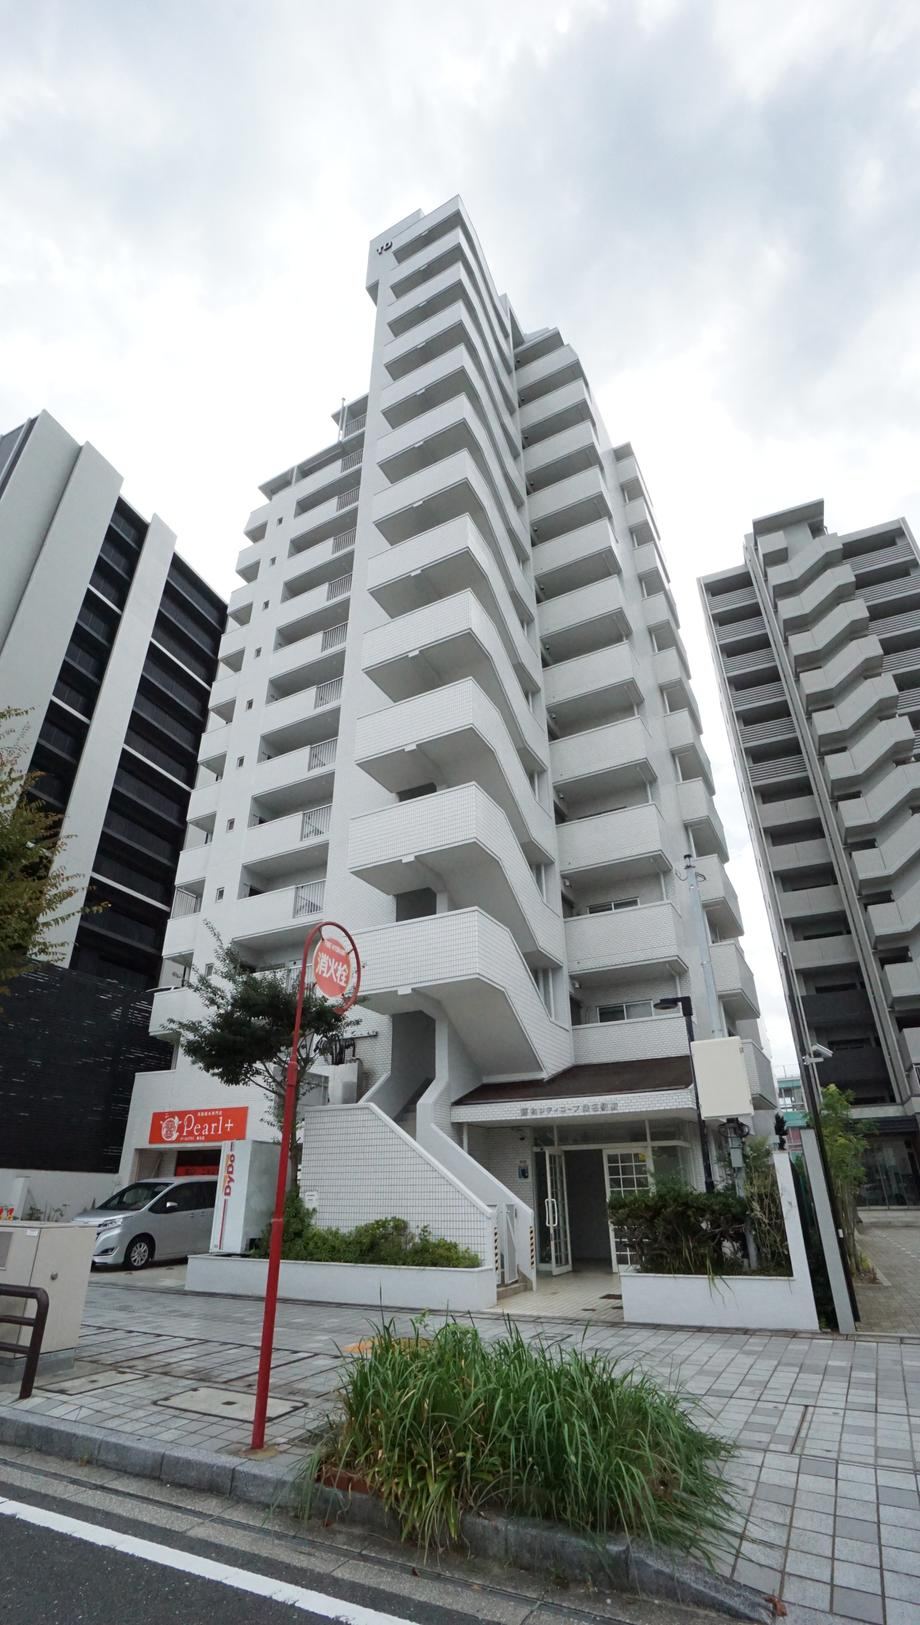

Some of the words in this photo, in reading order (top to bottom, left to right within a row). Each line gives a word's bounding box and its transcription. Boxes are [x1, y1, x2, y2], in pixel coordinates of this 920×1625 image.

[315, 951, 349, 987] 消火栓
[223, 1153, 236, 1197] DyDo
